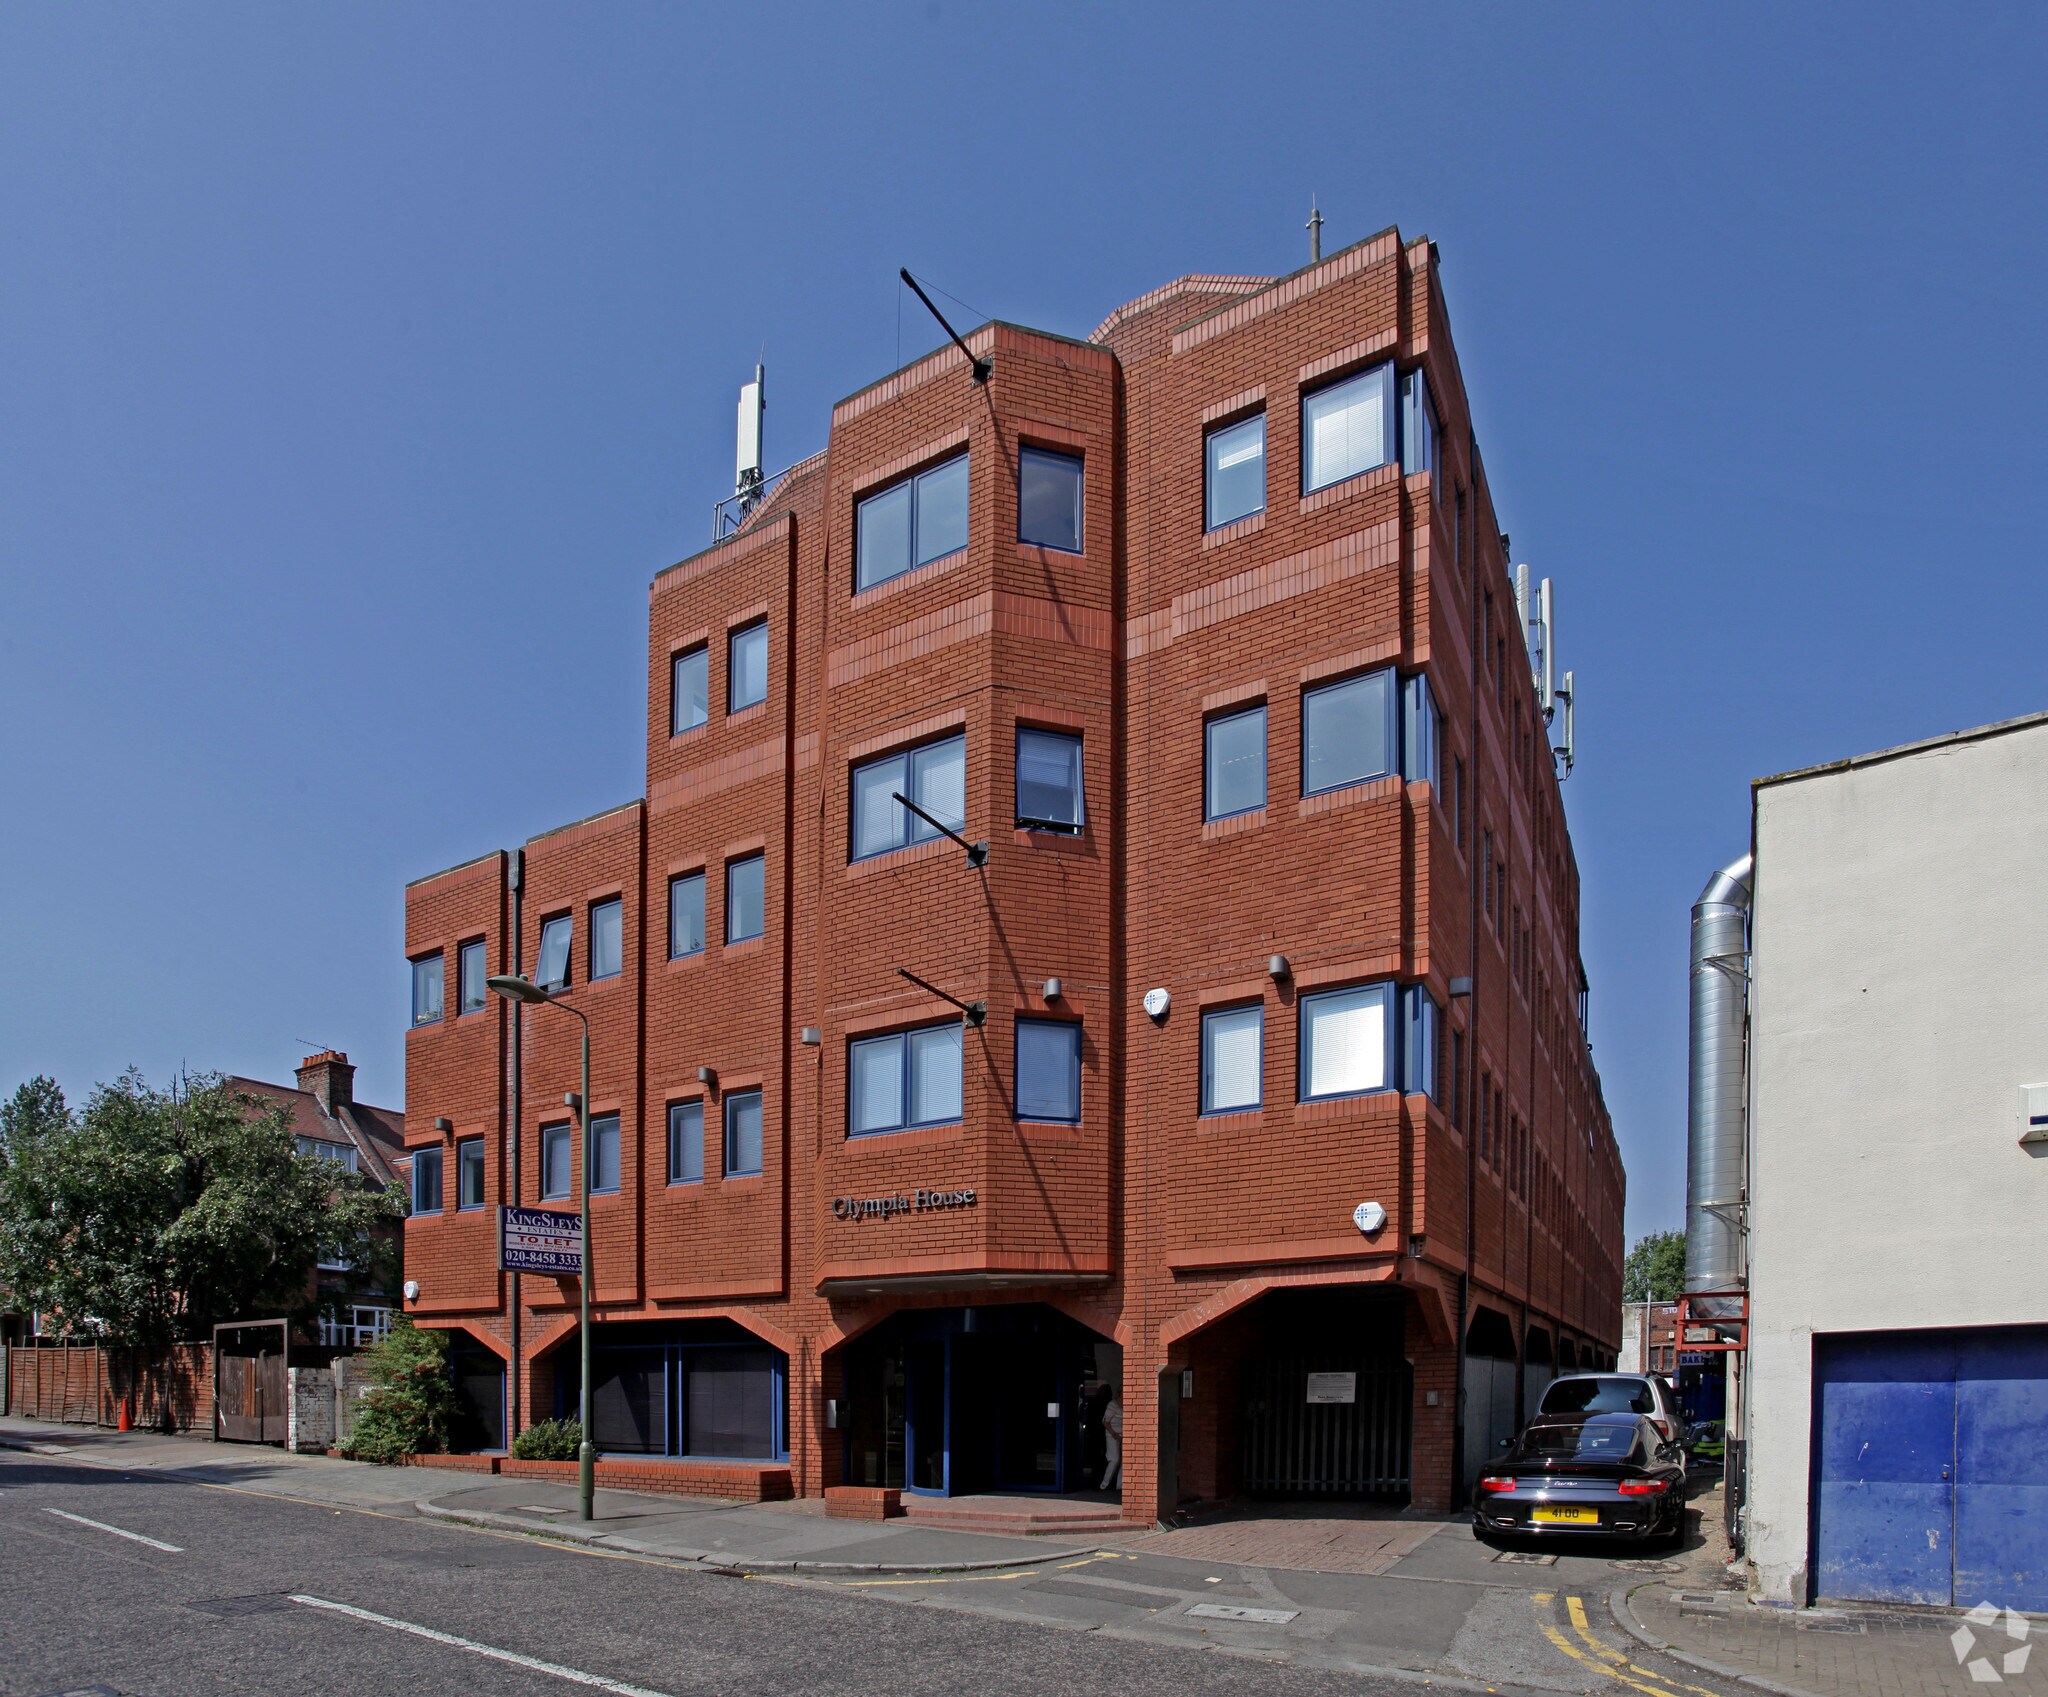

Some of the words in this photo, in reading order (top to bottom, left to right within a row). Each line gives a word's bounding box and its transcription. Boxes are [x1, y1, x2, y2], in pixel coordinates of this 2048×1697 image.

[831, 1191, 909, 1219] Olympia
[914, 1188, 976, 1208] House
[527, 1226, 563, 1236] ESTATES
[517, 1235, 539, 1243] TO
[544, 1238, 573, 1247] LET
[505, 1250, 556, 1264] 020-8458
